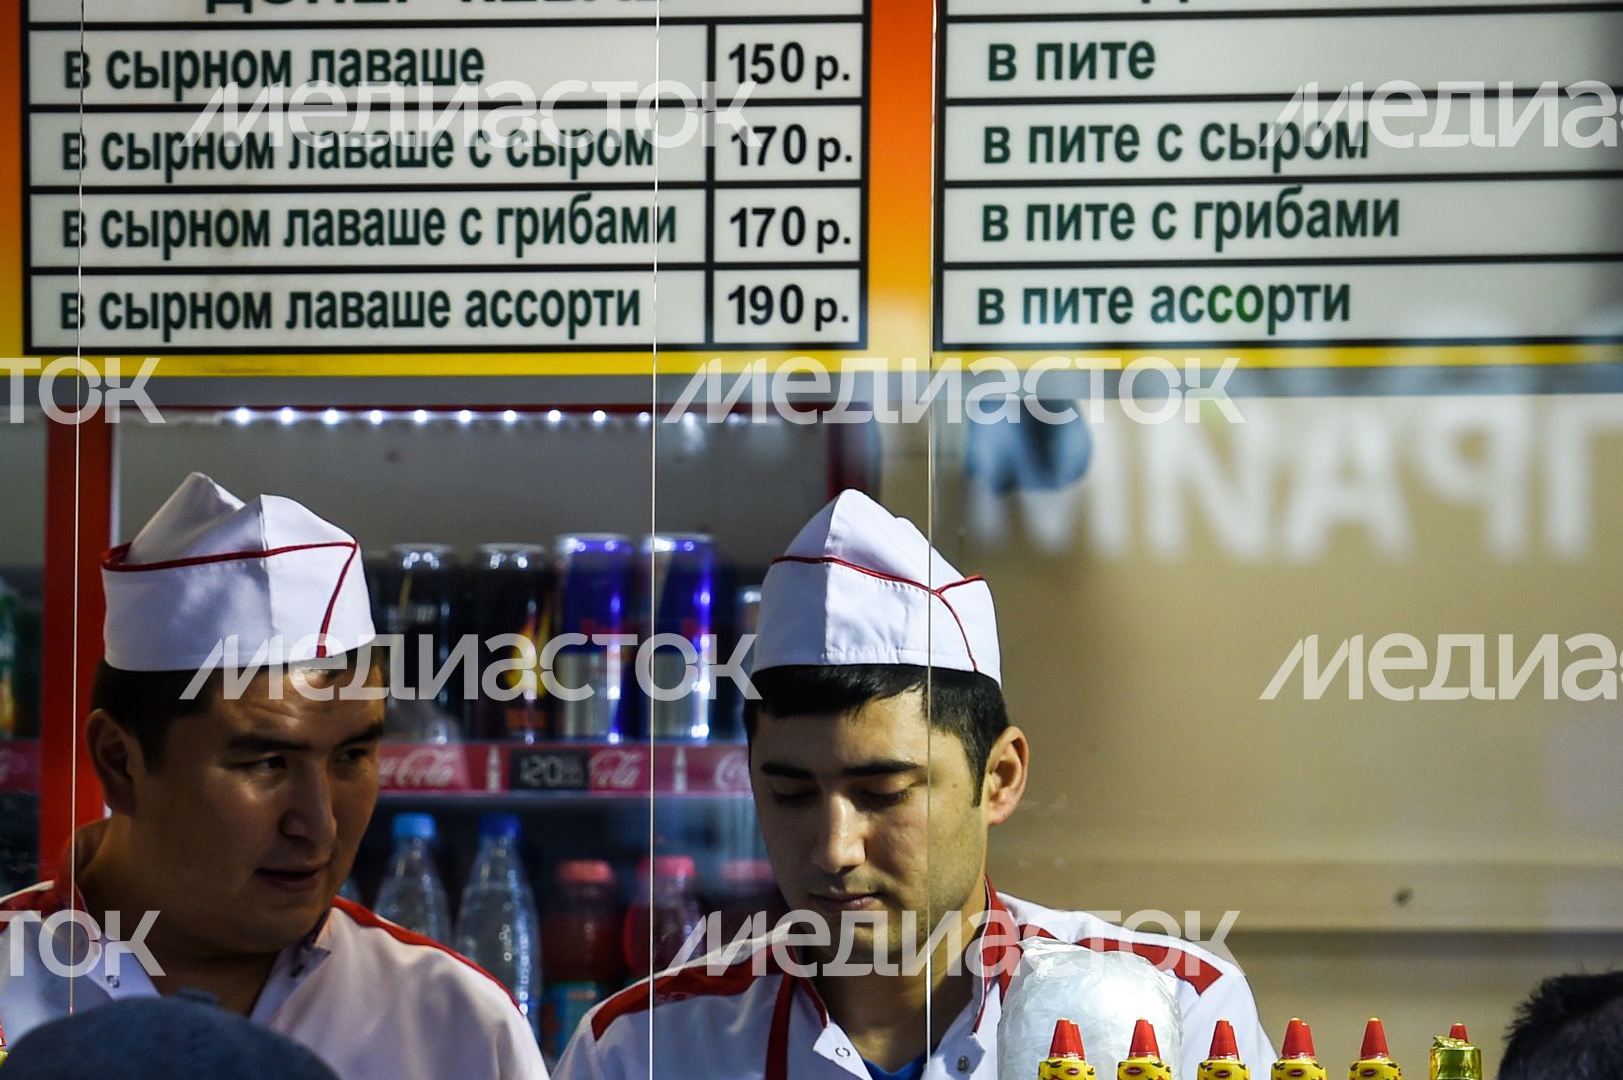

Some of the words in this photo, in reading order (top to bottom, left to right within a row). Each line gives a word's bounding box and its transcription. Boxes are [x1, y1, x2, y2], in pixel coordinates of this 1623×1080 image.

[64, 49, 92, 89] в
[106, 49, 293, 101] сырном
[311, 47, 485, 88] лаваше
[728, 42, 804, 86] 150
[815, 52, 851, 92] р.
[987, 43, 1016, 81] в
[1036, 39, 1156, 81] пите
[62, 132, 89, 173] в
[102, 129, 275, 180] сырном
[289, 128, 453, 171] лаваше
[468, 132, 491, 171] с
[506, 128, 654, 180] сыром
[728, 124, 807, 170] 170
[818, 134, 853, 173] р.
[984, 124, 1011, 164] в
[1028, 122, 1140, 163] пите
[1156, 121, 1182, 161] с
[1199, 120, 1369, 173] сыром
[62, 210, 88, 249] в
[101, 208, 271, 260] сырном
[284, 207, 446, 249] лаваше
[460, 207, 483, 245] с
[496, 192, 677, 257] грибами
[728, 206, 808, 249] 170
[818, 214, 851, 253] р.
[982, 203, 1009, 242] в
[1026, 201, 1135, 242] пите
[1151, 200, 1177, 240] с
[1194, 186, 1400, 252] грибами
[61, 292, 87, 331] в
[99, 289, 272, 342] сырном
[286, 289, 451, 329] лаваше
[465, 286, 641, 341] ассорти
[728, 285, 804, 328] 190
[815, 293, 850, 332] р.
[978, 287, 1004, 326] в
[1022, 285, 1134, 326] пите
[1150, 282, 1351, 335] ассорти
